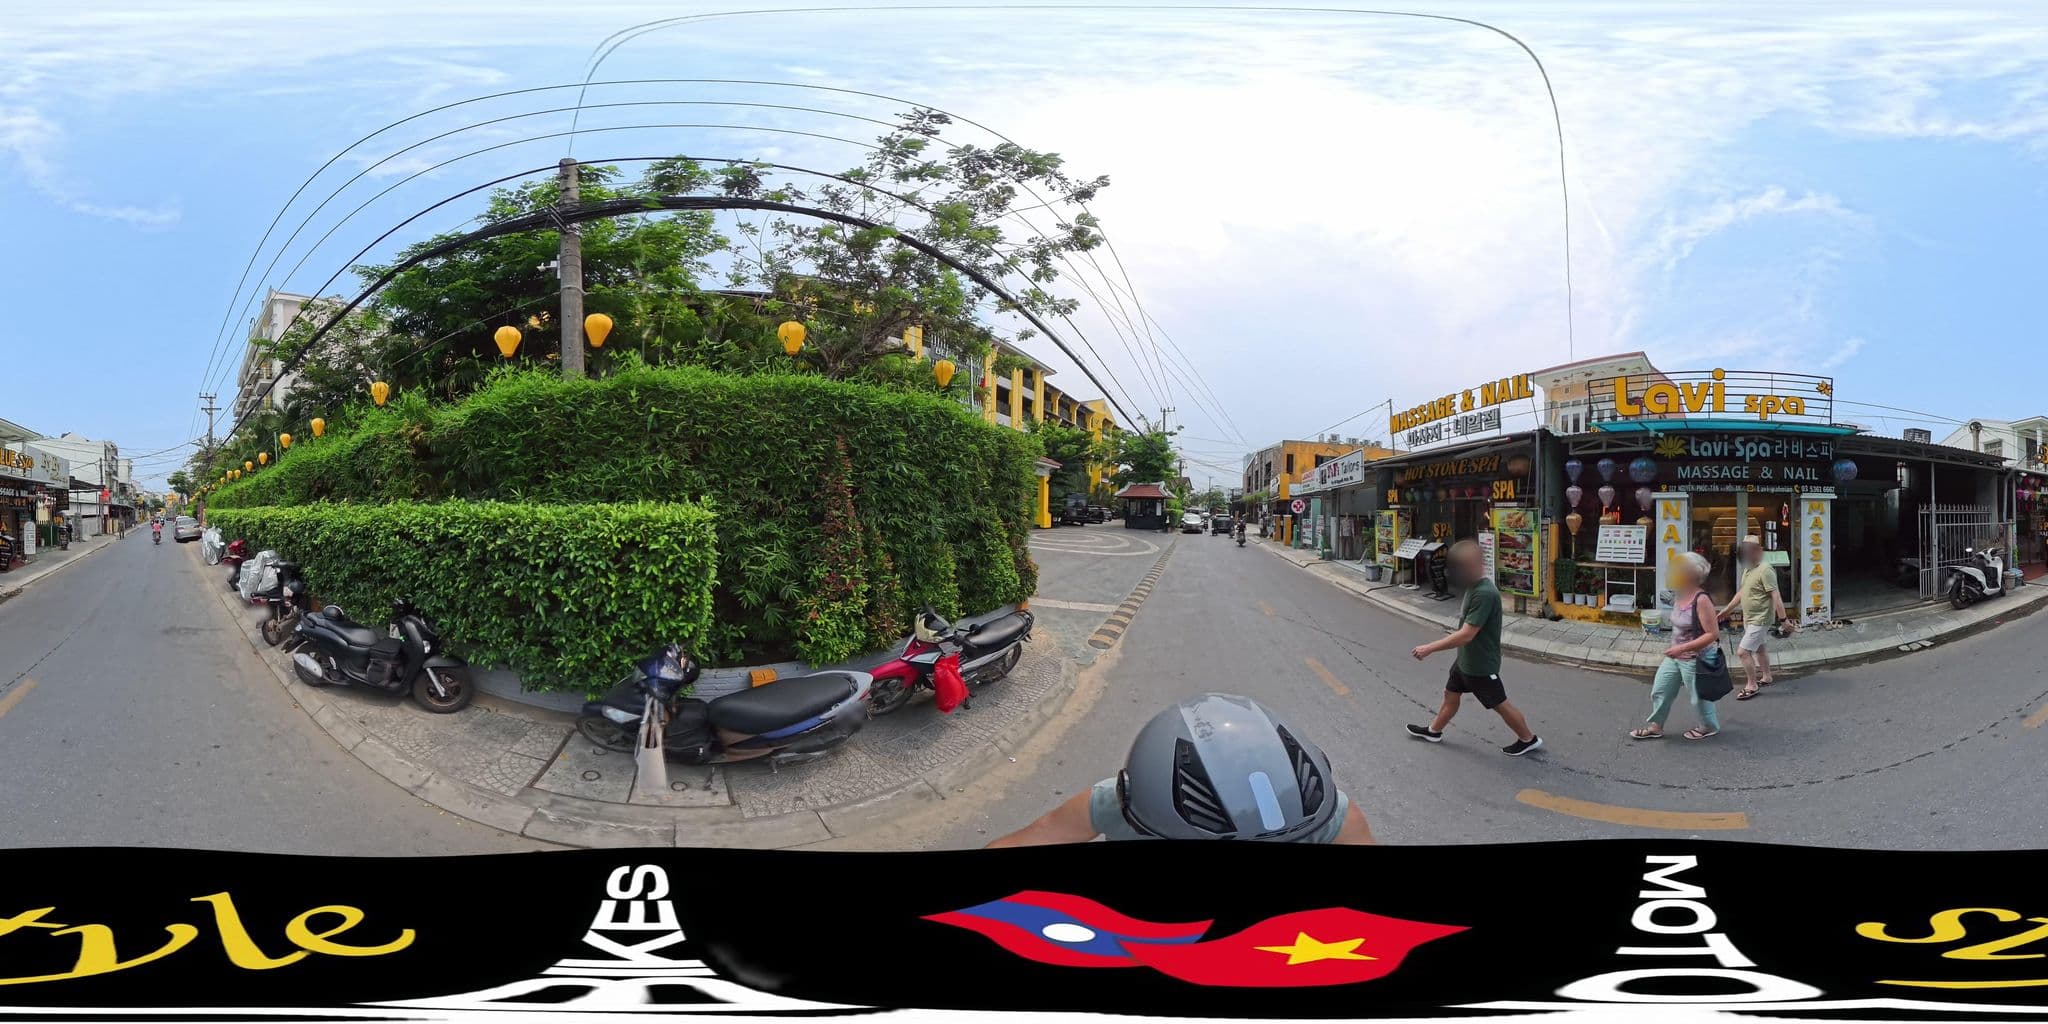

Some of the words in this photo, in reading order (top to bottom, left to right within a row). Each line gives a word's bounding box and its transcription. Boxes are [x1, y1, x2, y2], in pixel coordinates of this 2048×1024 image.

[1390, 393, 1457, 434] MASSAGE
[1460, 389, 1475, 412] &
[1480, 374, 1534, 409] NAIL
[1614, 368, 1725, 416] Lavi
[1744, 394, 1805, 420] spa
[1406, 422, 1442, 447] 마사지
[1690, 434, 1728, 457] Lavi
[1735, 436, 1771, 463] Spa
[1775, 437, 1834, 461] 라비스파
[1404, 463, 1425, 481] HOT
[1427, 458, 1469, 478] STONE
[1471, 453, 1502, 473] SPA
[1677, 465, 1750, 479] MASSAGE
[1760, 466, 1773, 479] &
[1783, 467, 1818, 480] NAIL
[1387, 489, 1399, 504] SPA
[1493, 480, 1515, 499] SPA
[1432, 521, 1454, 539] SPA
[1662, 501, 1681, 590] NAI
[1807, 500, 1825, 607] MASSAGE
